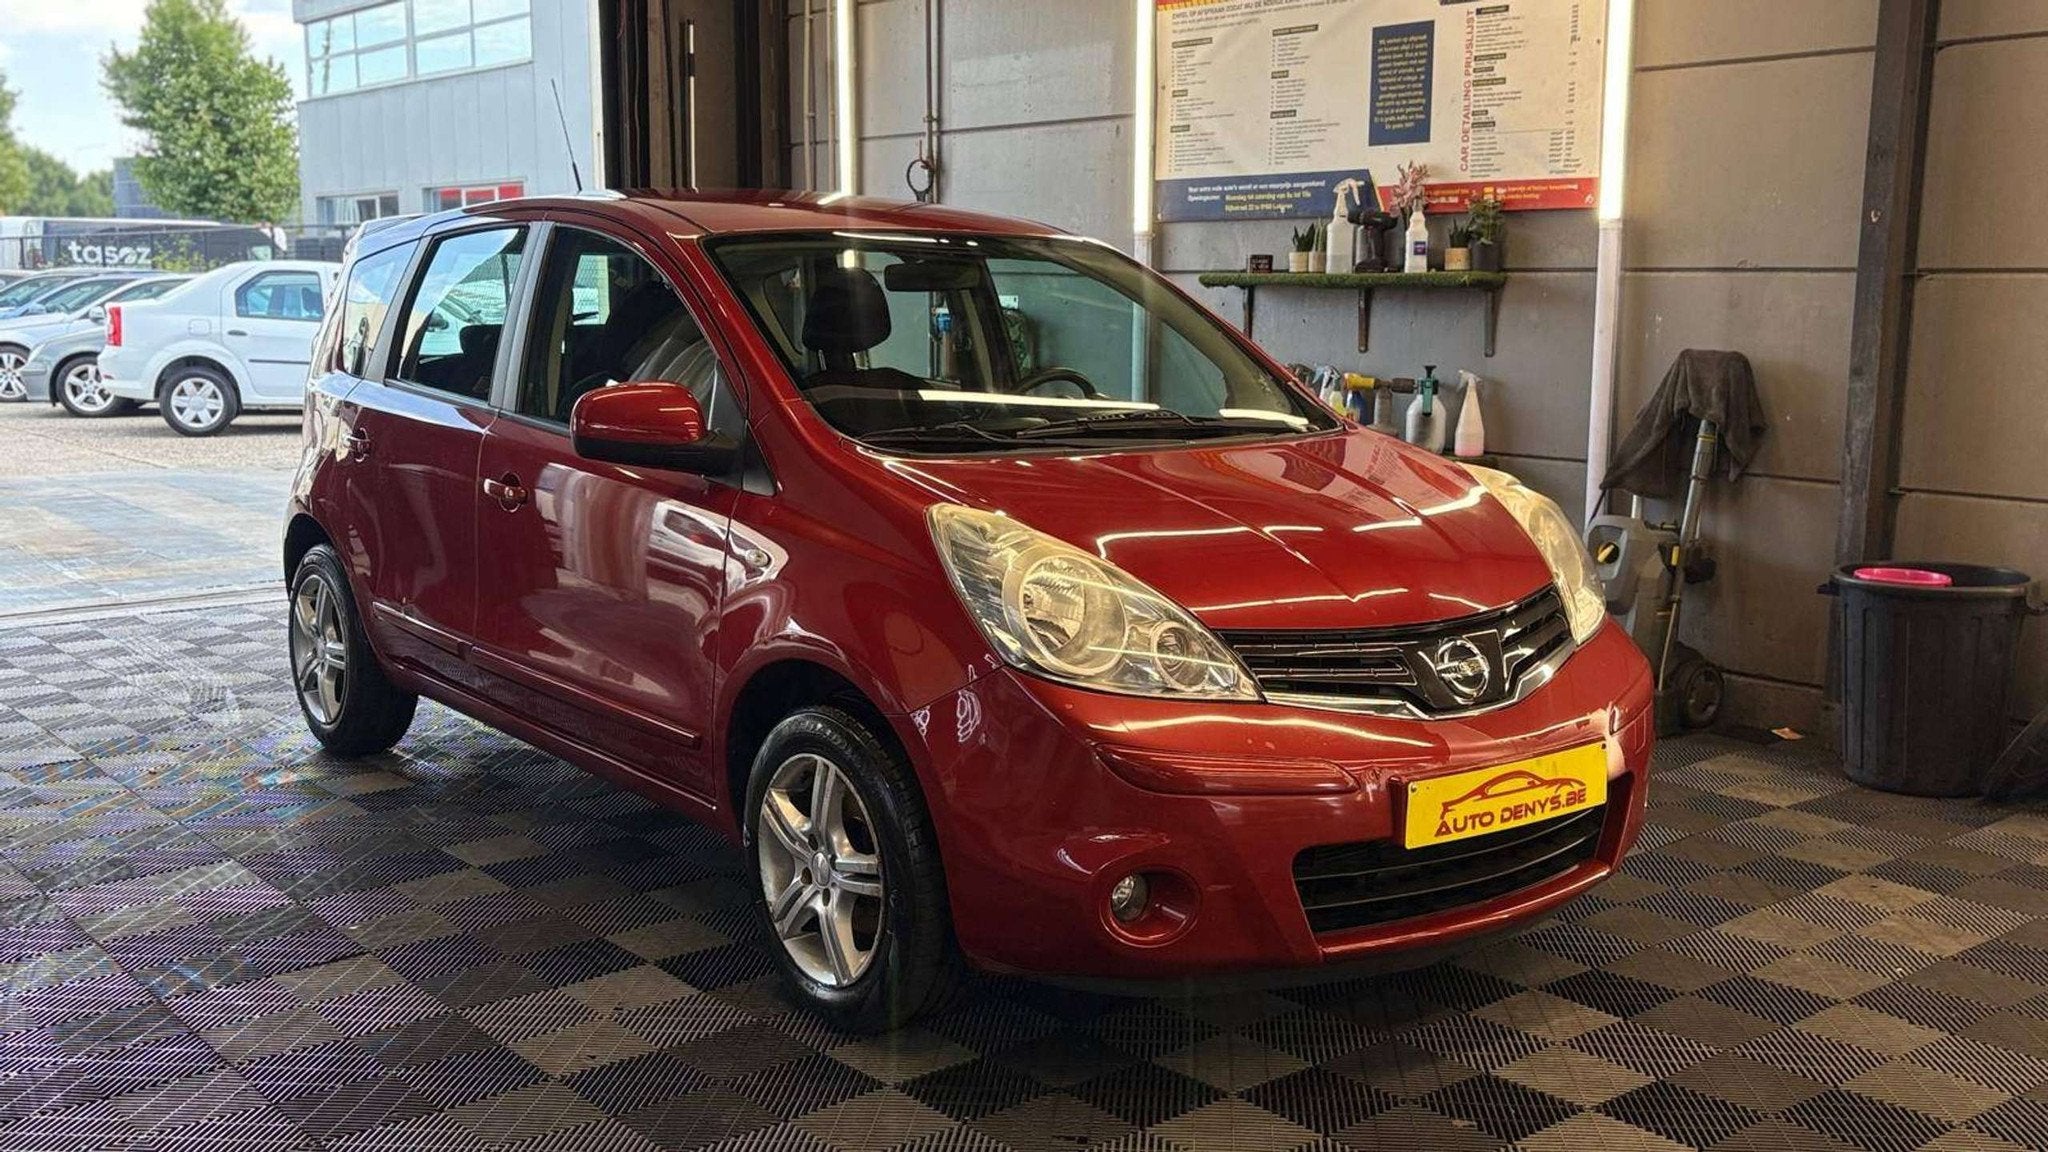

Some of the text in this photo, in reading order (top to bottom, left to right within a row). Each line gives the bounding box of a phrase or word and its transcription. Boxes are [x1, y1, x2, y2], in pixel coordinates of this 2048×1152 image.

[1460, 10, 1475, 172] CAR DETAILING PRIJSLIJST
[1434, 788, 1586, 836] AUTO DENYS.BE
